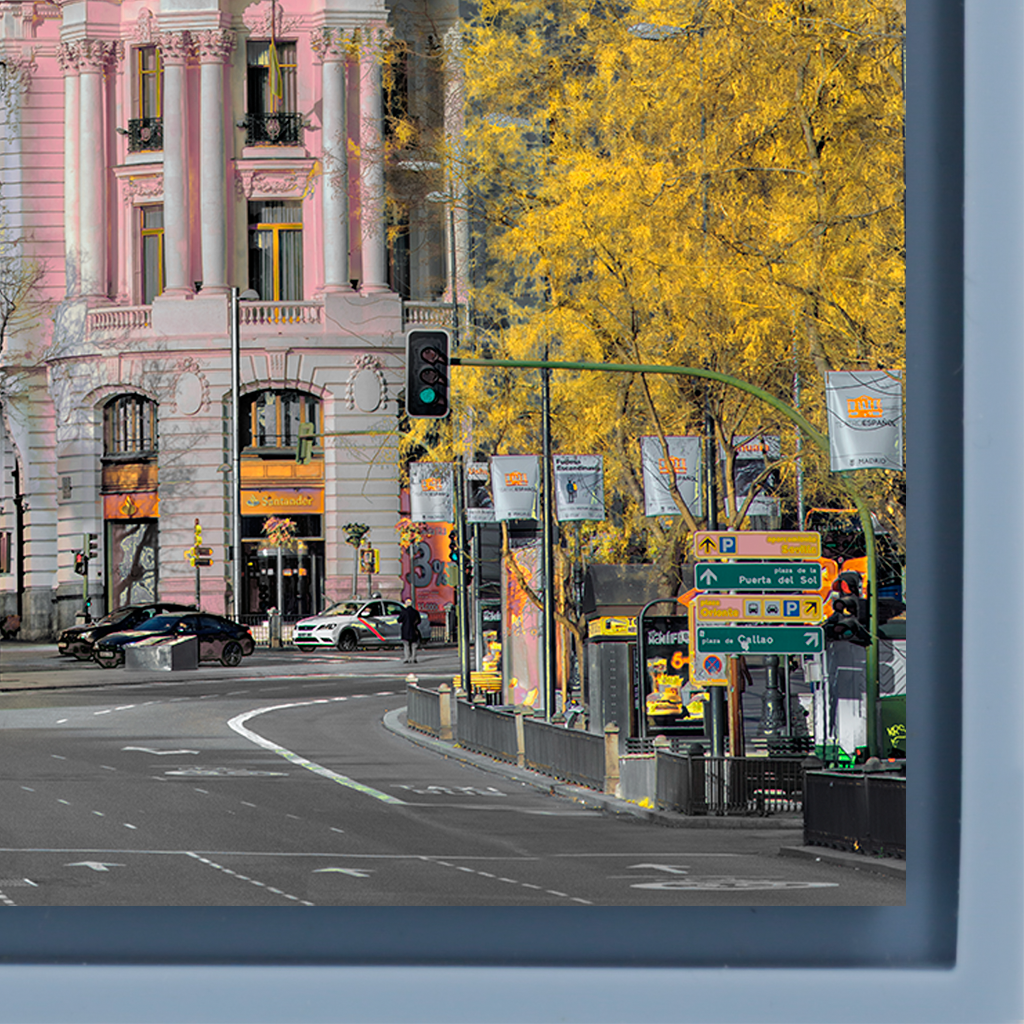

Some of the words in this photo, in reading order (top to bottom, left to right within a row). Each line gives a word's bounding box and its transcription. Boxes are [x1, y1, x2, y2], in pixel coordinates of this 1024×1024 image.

[262, 494, 313, 506] Santander
[781, 544, 817, 555] Sevilla
[774, 567, 793, 575] plaza
[739, 576, 772, 584] Puerta
[778, 576, 794, 584] del
[800, 576, 817, 584] Sol
[700, 607, 740, 617] Oriente
[737, 634, 774, 644] Callao
